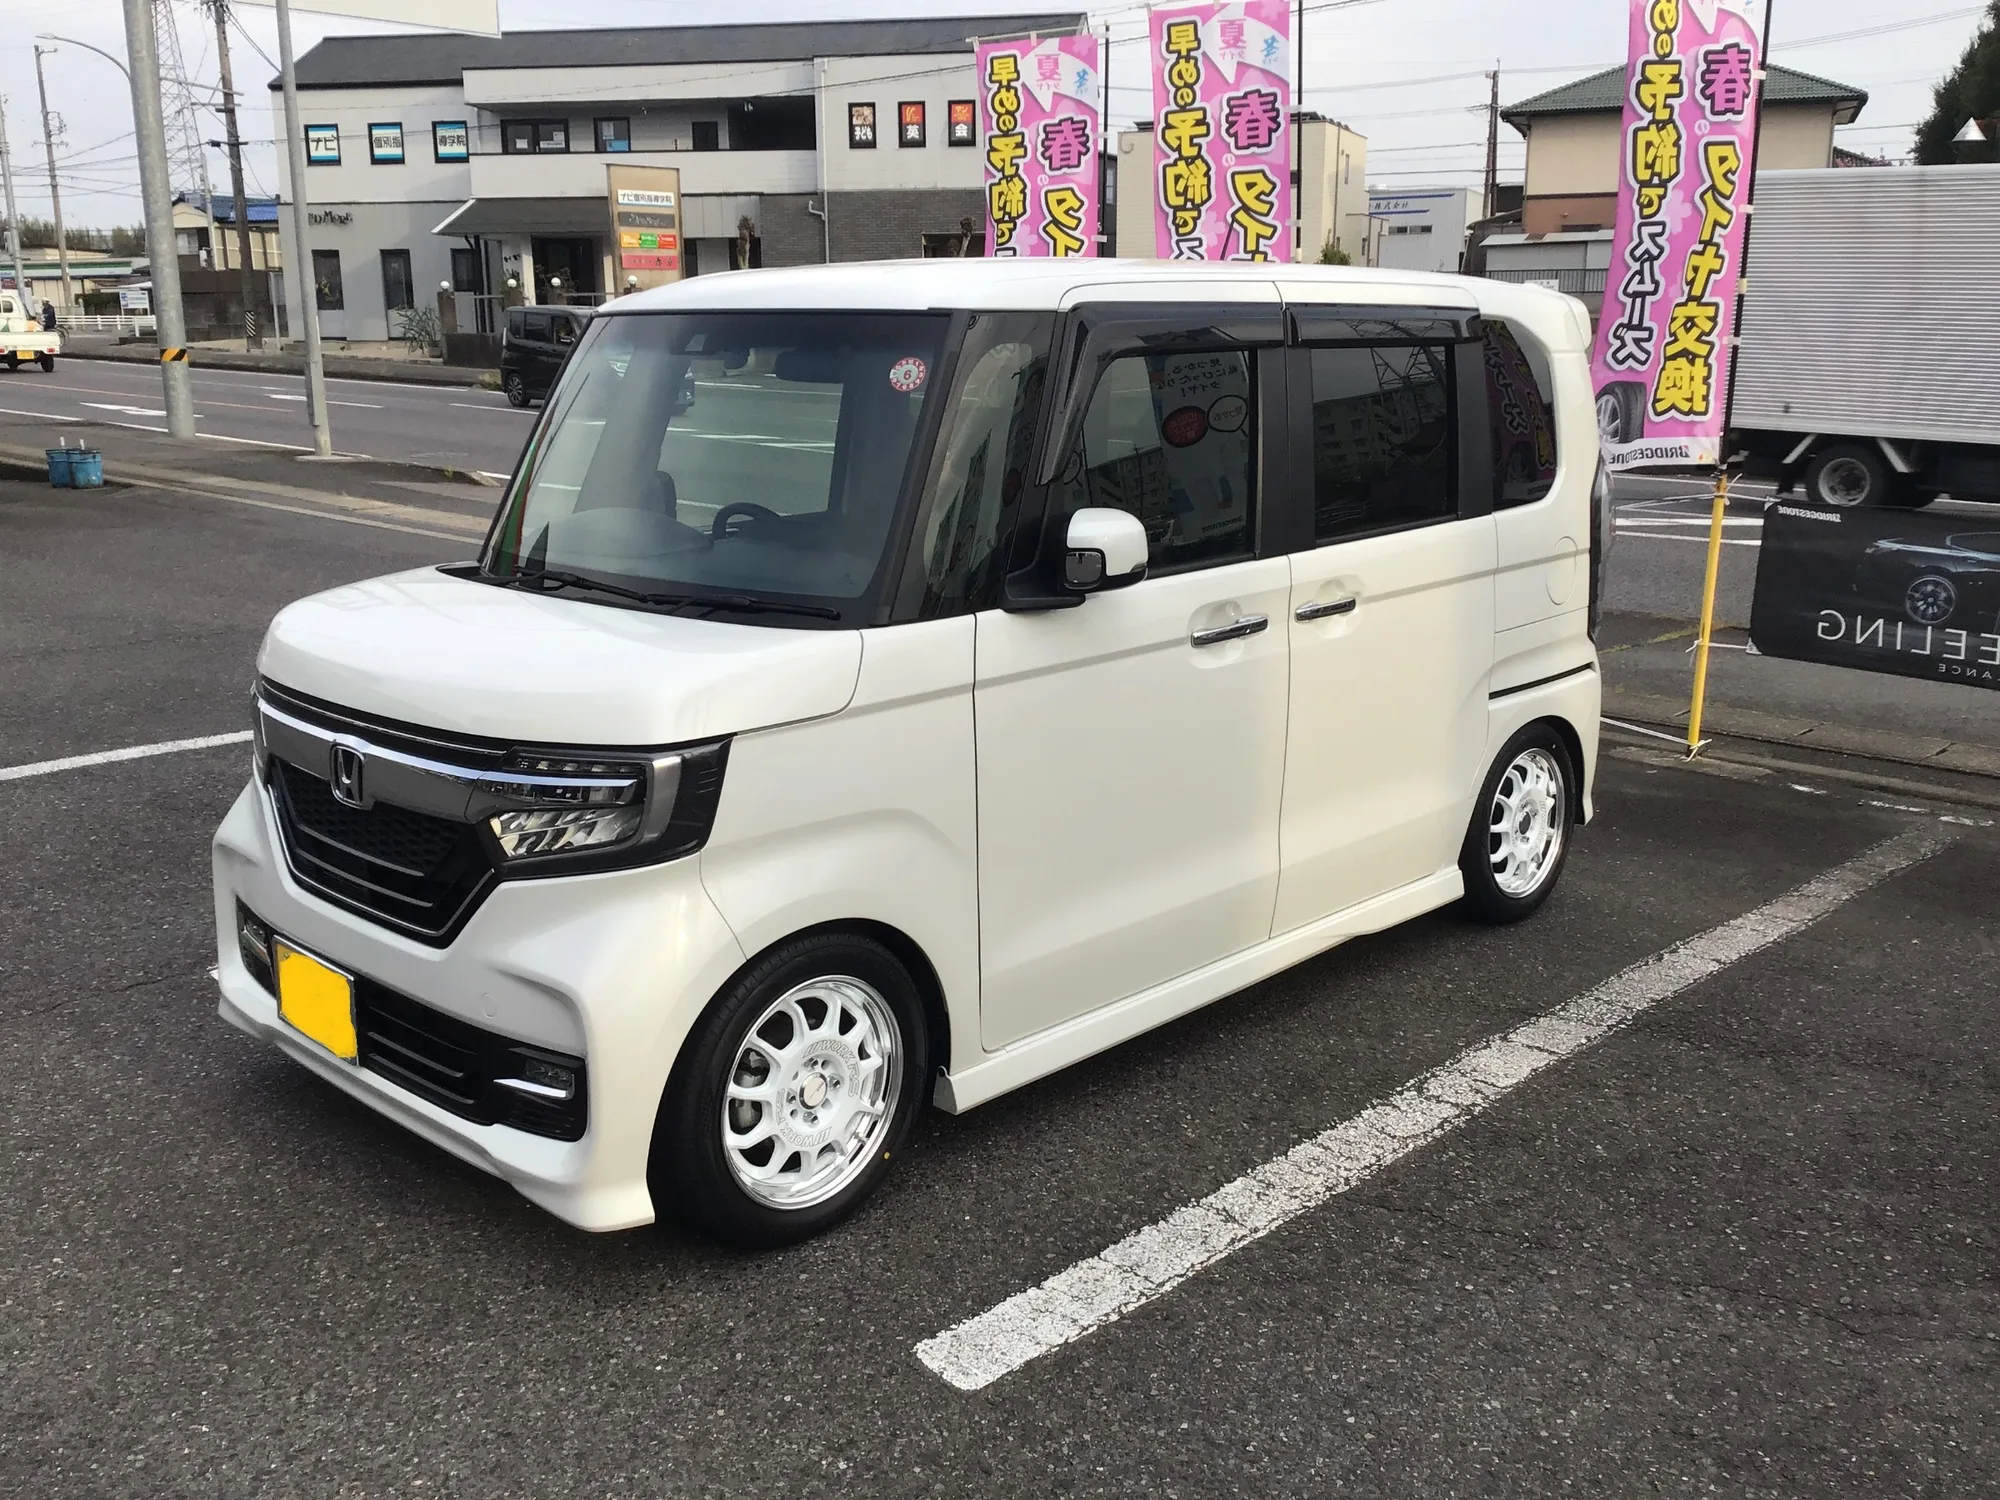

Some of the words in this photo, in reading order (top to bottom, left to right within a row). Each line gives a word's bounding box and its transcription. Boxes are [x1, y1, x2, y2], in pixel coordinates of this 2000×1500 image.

[854, 126, 873, 140] 子ども
[906, 124, 919, 139] 英
[955, 123, 968, 137] 会
[310, 134, 338, 151] ナビ
[373, 136, 402, 148] 個別指
[438, 135, 466, 147] 導学院
[903, 370, 912, 380] 6
